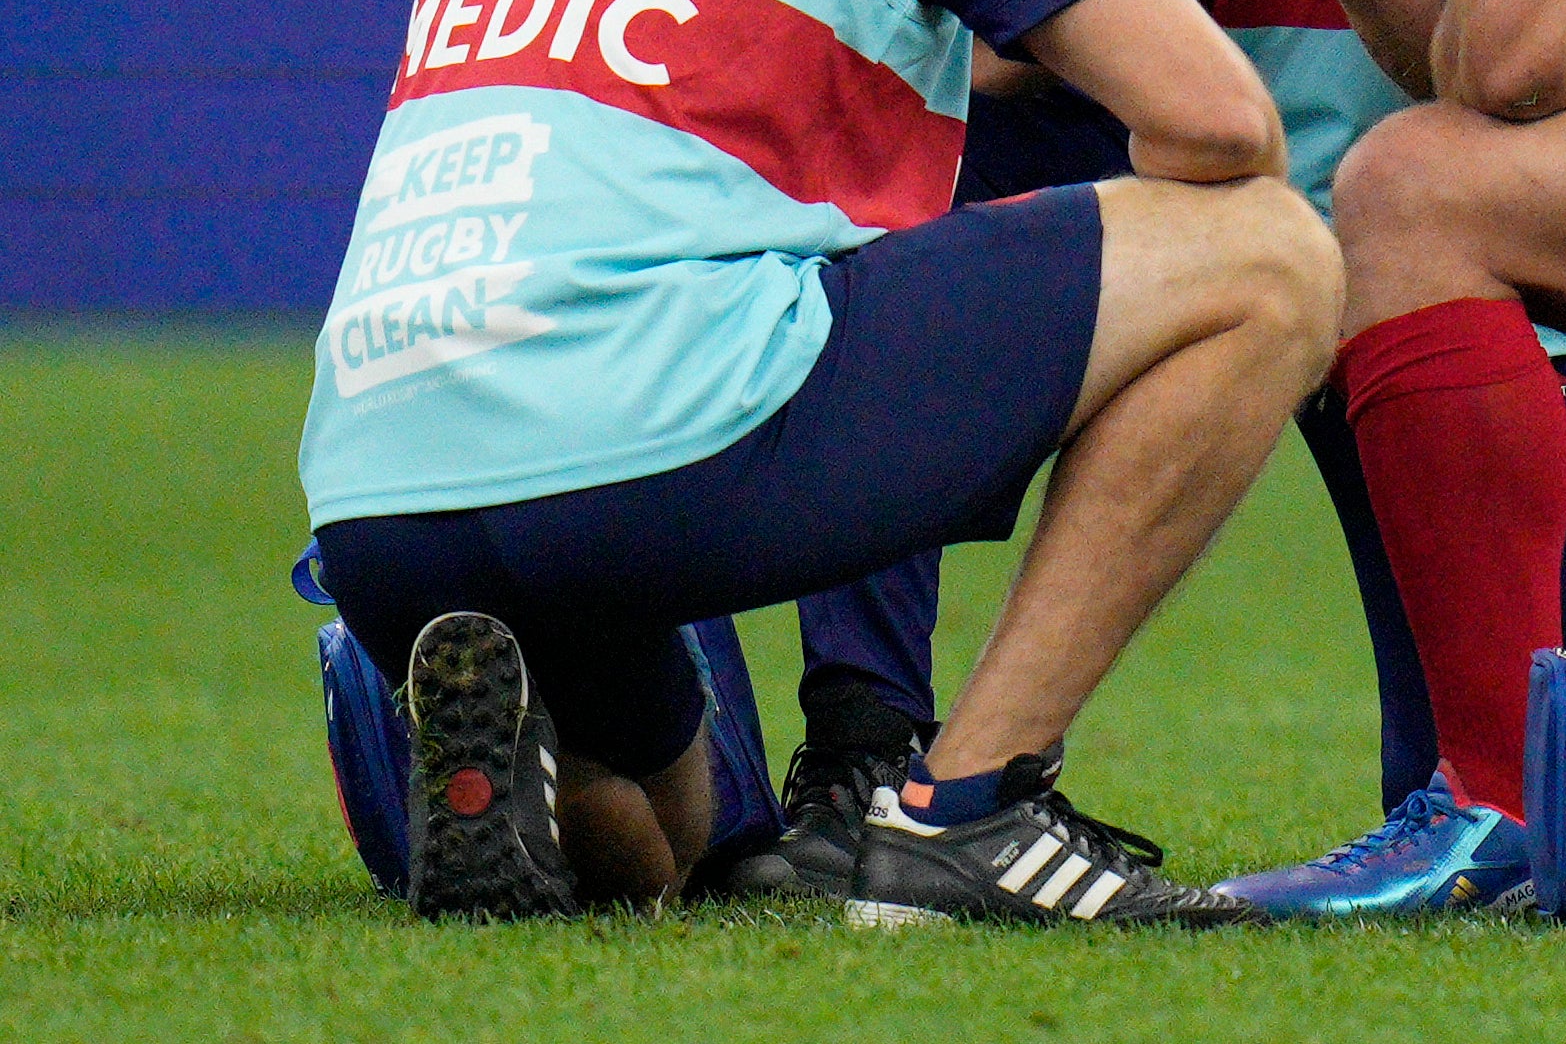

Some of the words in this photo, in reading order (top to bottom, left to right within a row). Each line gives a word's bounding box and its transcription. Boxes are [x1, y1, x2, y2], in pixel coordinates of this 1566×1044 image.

[398, 132, 522, 203] KEEP
[353, 212, 528, 295] RUGBY
[341, 277, 486, 369] CLEAN
